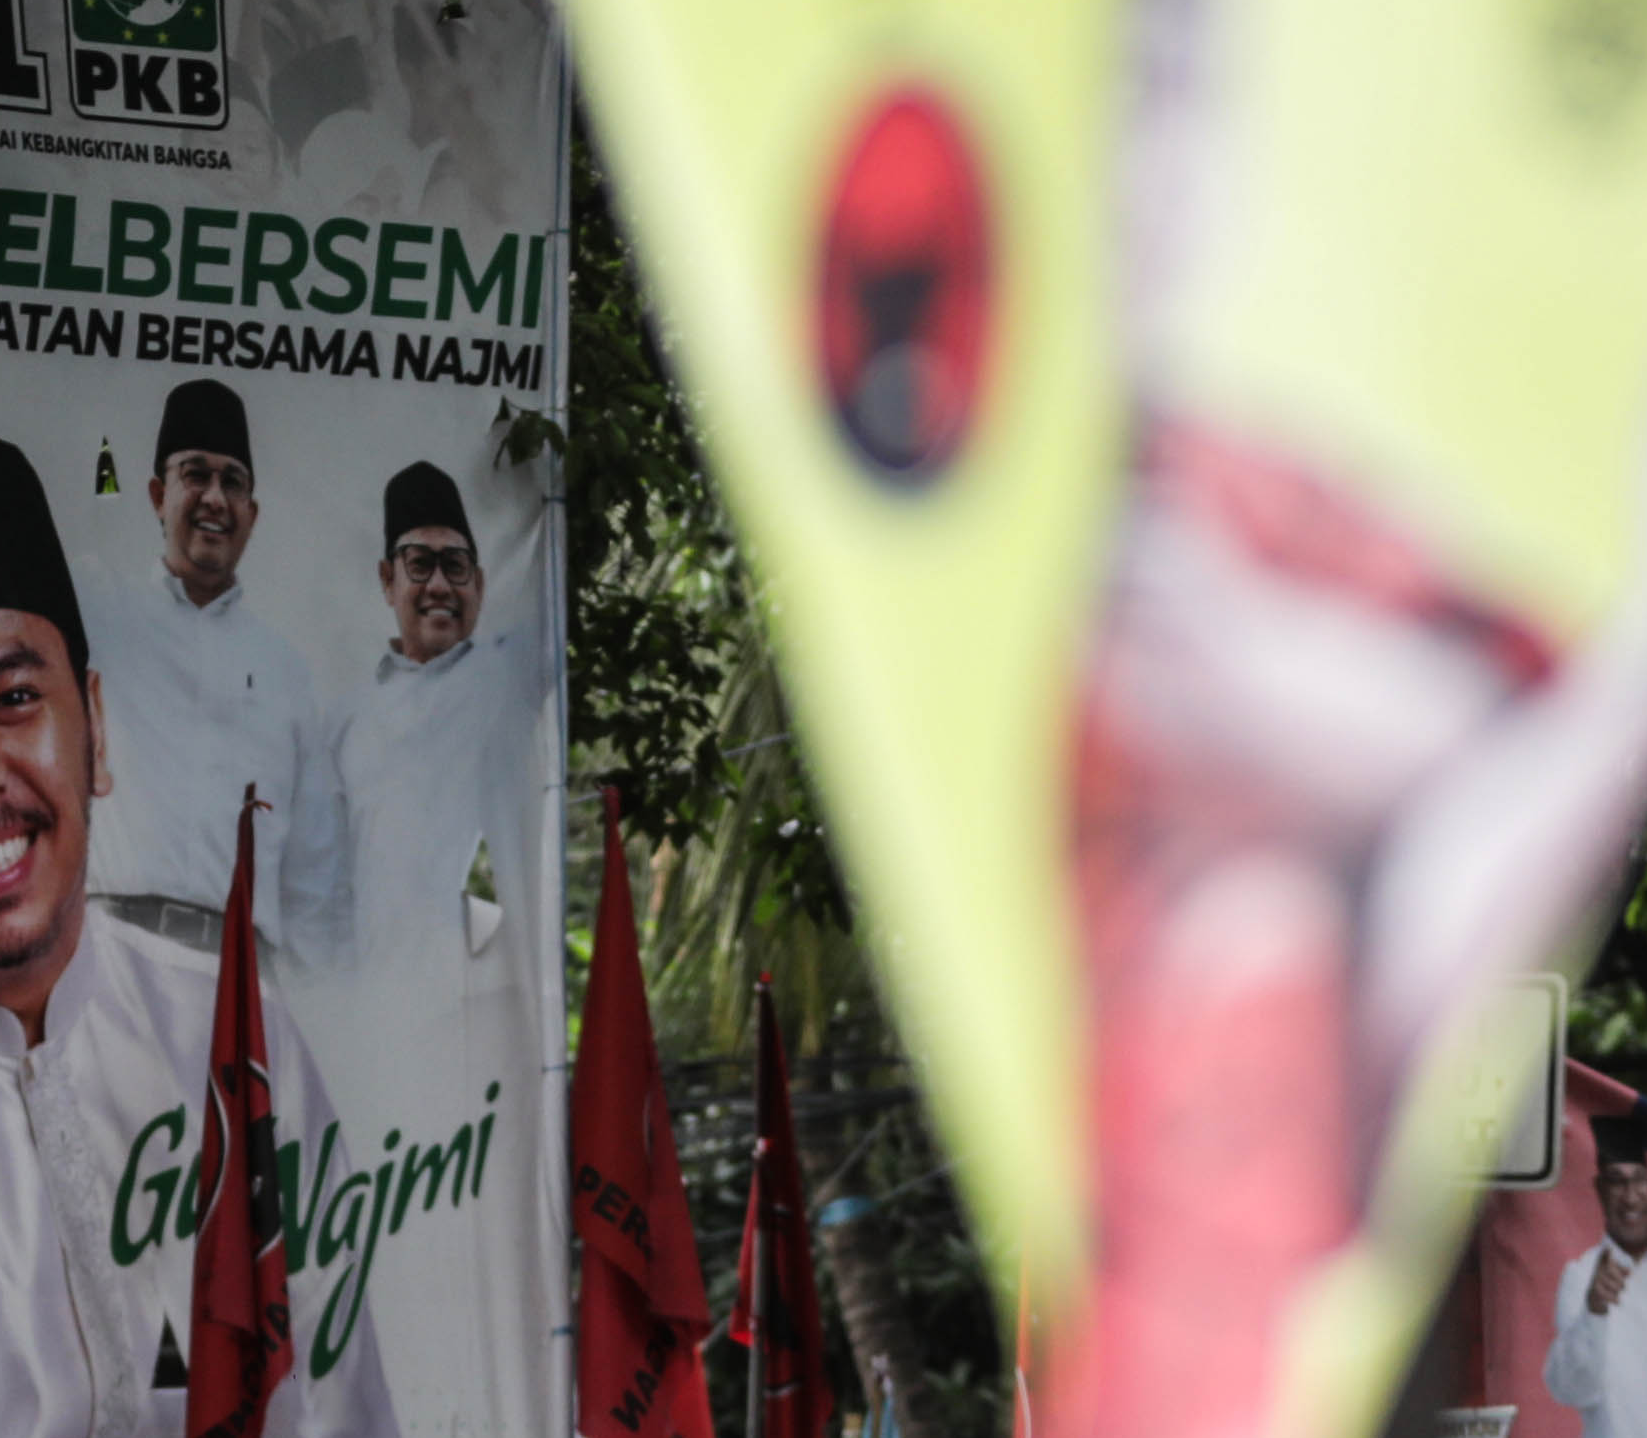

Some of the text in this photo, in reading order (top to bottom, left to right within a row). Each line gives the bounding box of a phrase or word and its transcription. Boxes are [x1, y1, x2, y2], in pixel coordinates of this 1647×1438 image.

[74, 50, 222, 119] PKB
[21, 131, 149, 164] KEBANGKITAN
[152, 143, 233, 172] BANGSA
[135, 312, 382, 379] BERSAMA
[392, 333, 544, 393] NAJMI
